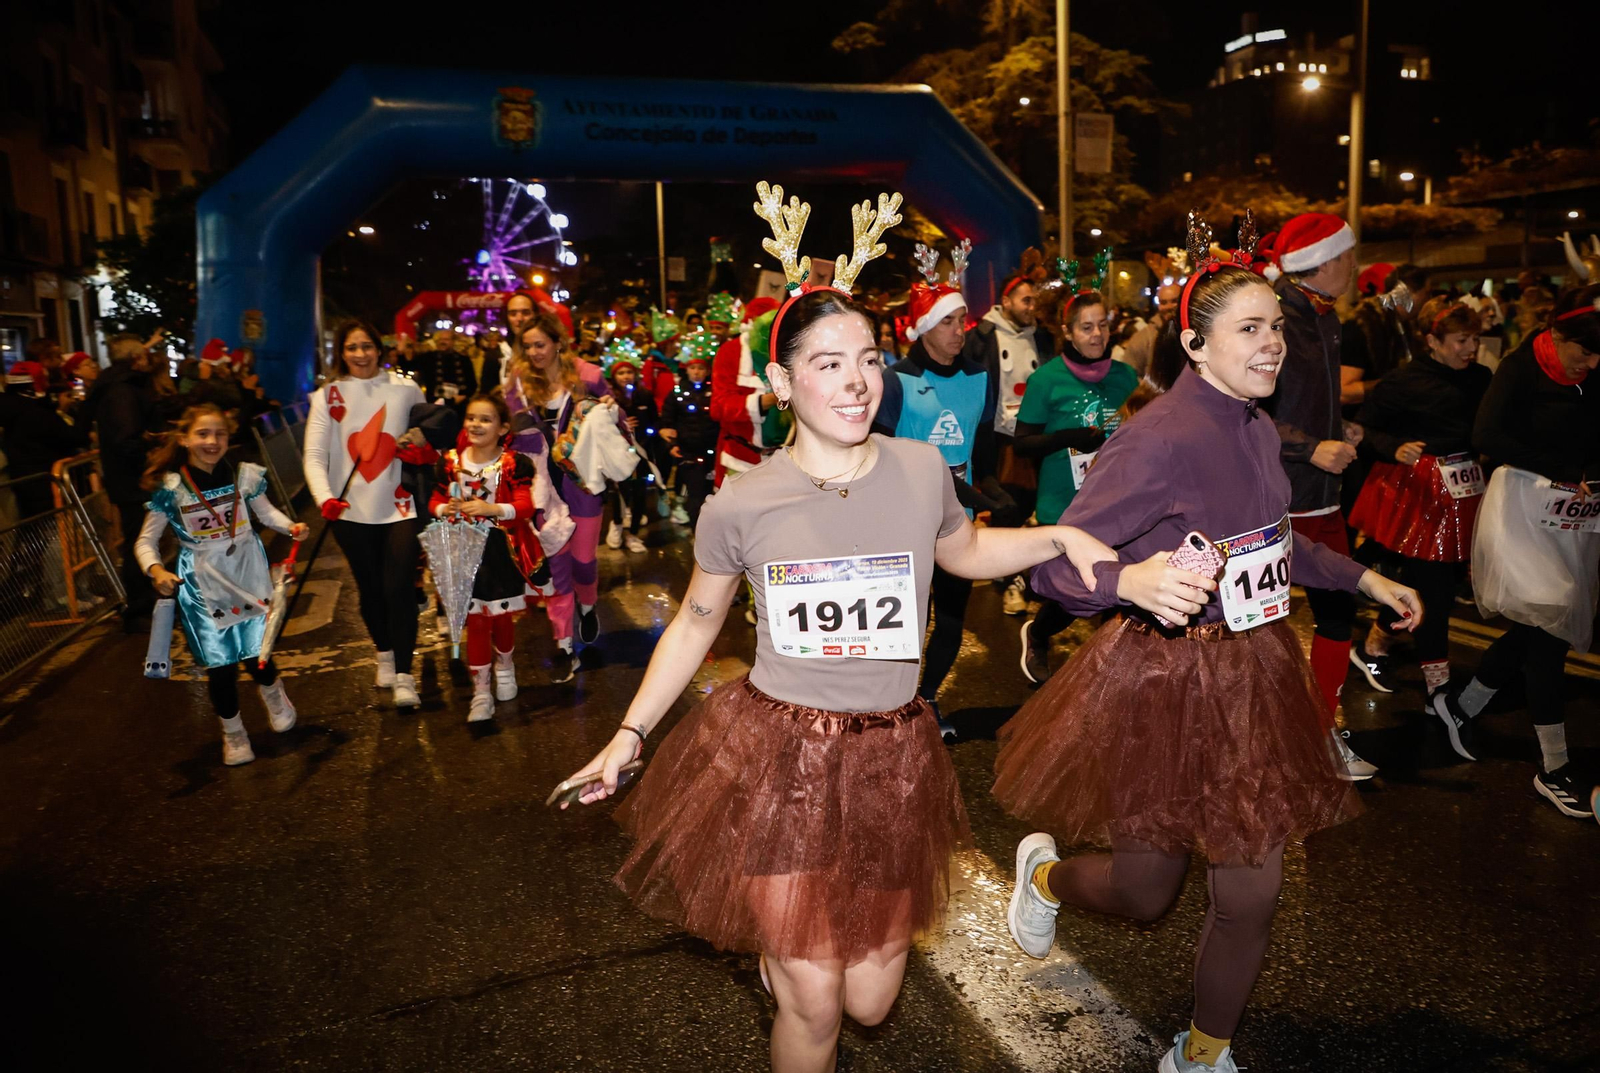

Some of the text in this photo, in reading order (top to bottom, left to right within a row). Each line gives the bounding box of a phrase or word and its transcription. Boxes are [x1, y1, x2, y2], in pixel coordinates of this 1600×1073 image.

[702, 125, 727, 143] de
[734, 126, 818, 147] Deportes
[327, 385, 345, 405] A
[395, 501, 411, 518] A
[1554, 499, 1600, 518] 1609
[1228, 531, 1265, 550] CARRERA
[1229, 539, 1267, 557] NOCTURNA
[770, 565, 785, 585] 33
[784, 562, 833, 576] CARRERA
[785, 572, 834, 584] NOCTURNA
[788, 596, 904, 633] 1912
[851, 635, 871, 643] SEGURA
